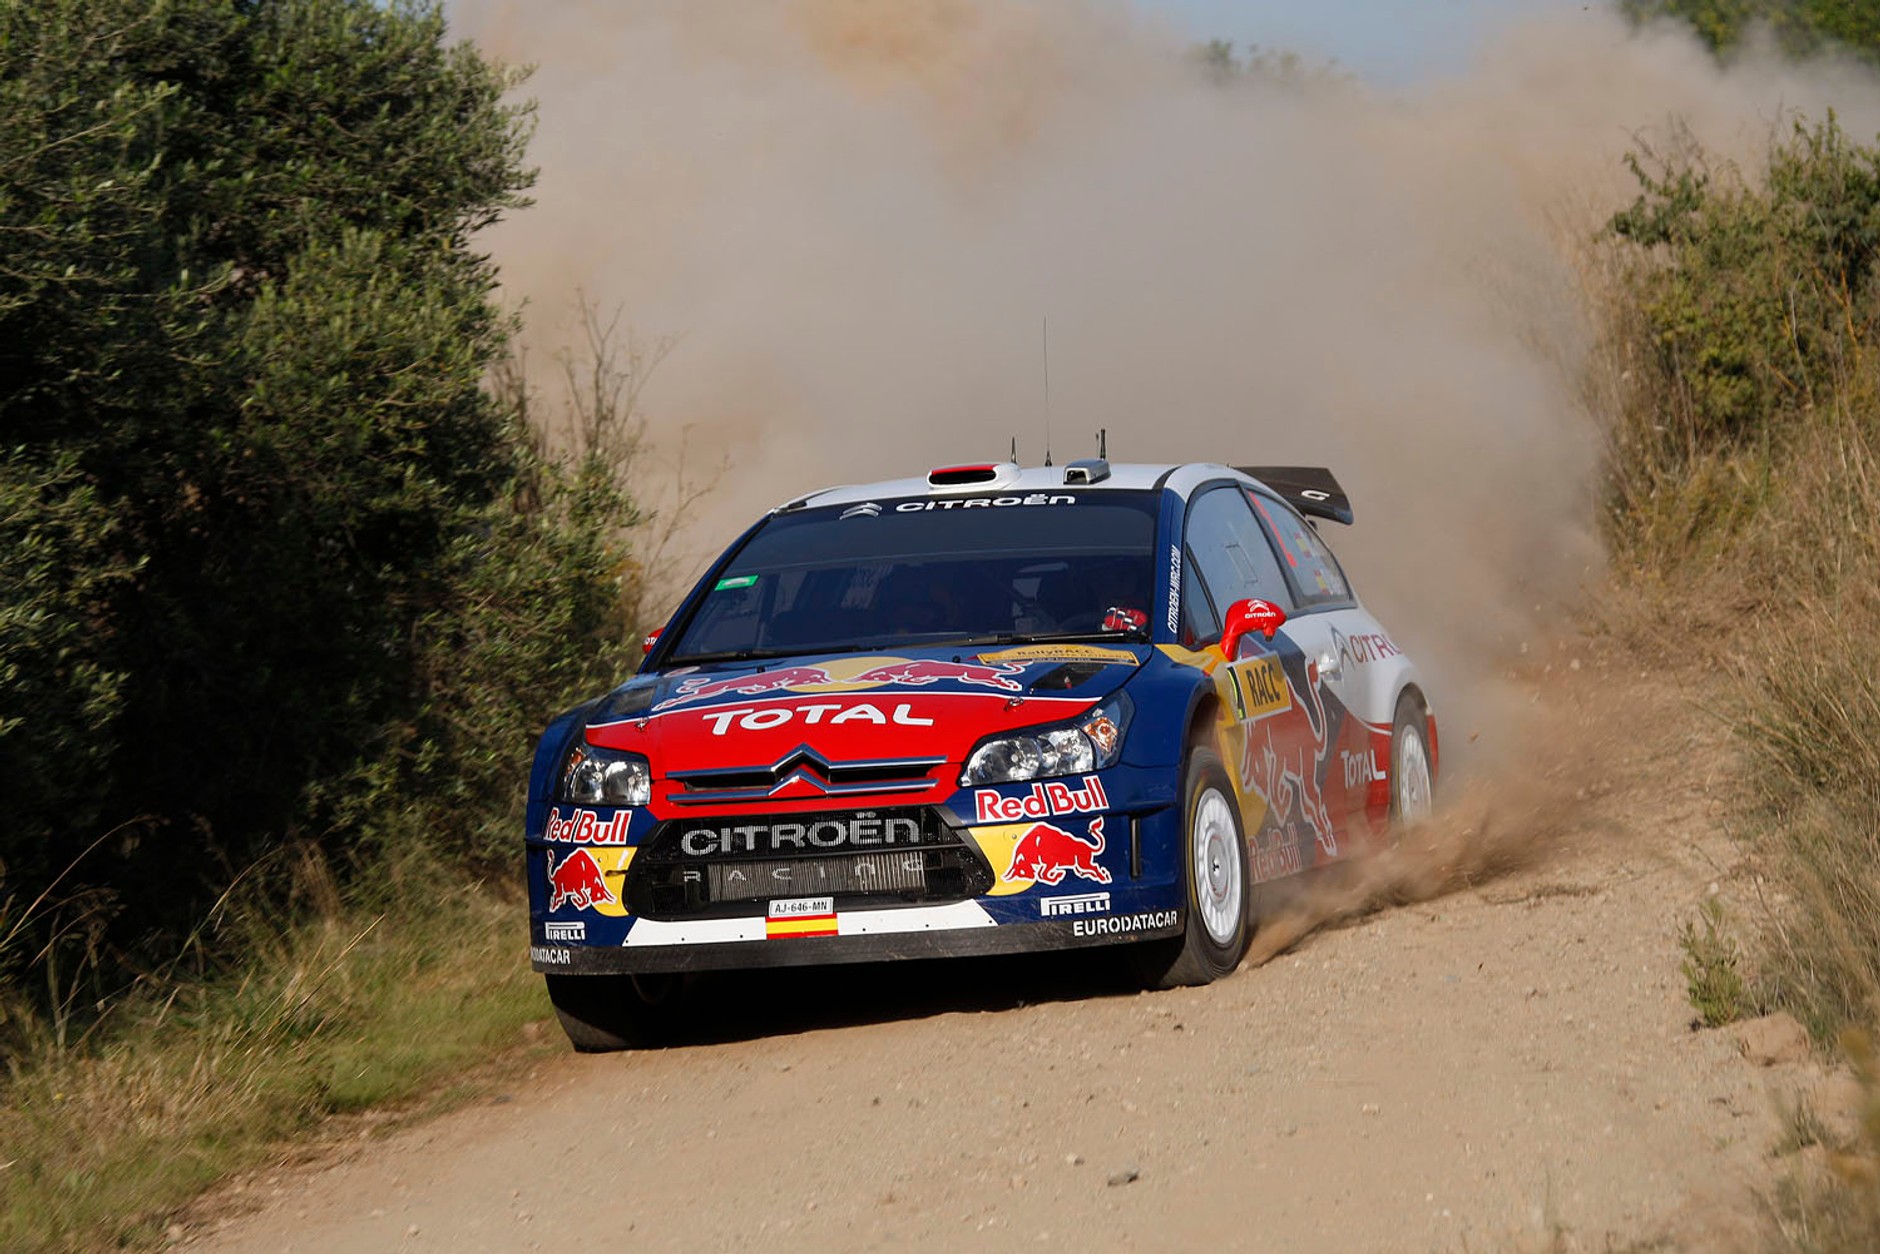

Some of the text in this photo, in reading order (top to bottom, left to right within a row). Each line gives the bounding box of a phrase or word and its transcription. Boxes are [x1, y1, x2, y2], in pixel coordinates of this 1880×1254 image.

[1246, 663, 1281, 707] RACC
[702, 703, 934, 735] TOTAL
[1340, 749, 1386, 789] TOTAL
[975, 775, 1110, 823] Red Bull
[544, 807, 632, 845] Red Bull
[681, 811, 919, 856] CITROËN
[775, 901, 827, 913] AJ-646-MN
[1040, 892, 1110, 916] PIRELLI
[544, 921, 585, 940] PIRELLI
[1073, 910, 1177, 937] EURODATACAR
